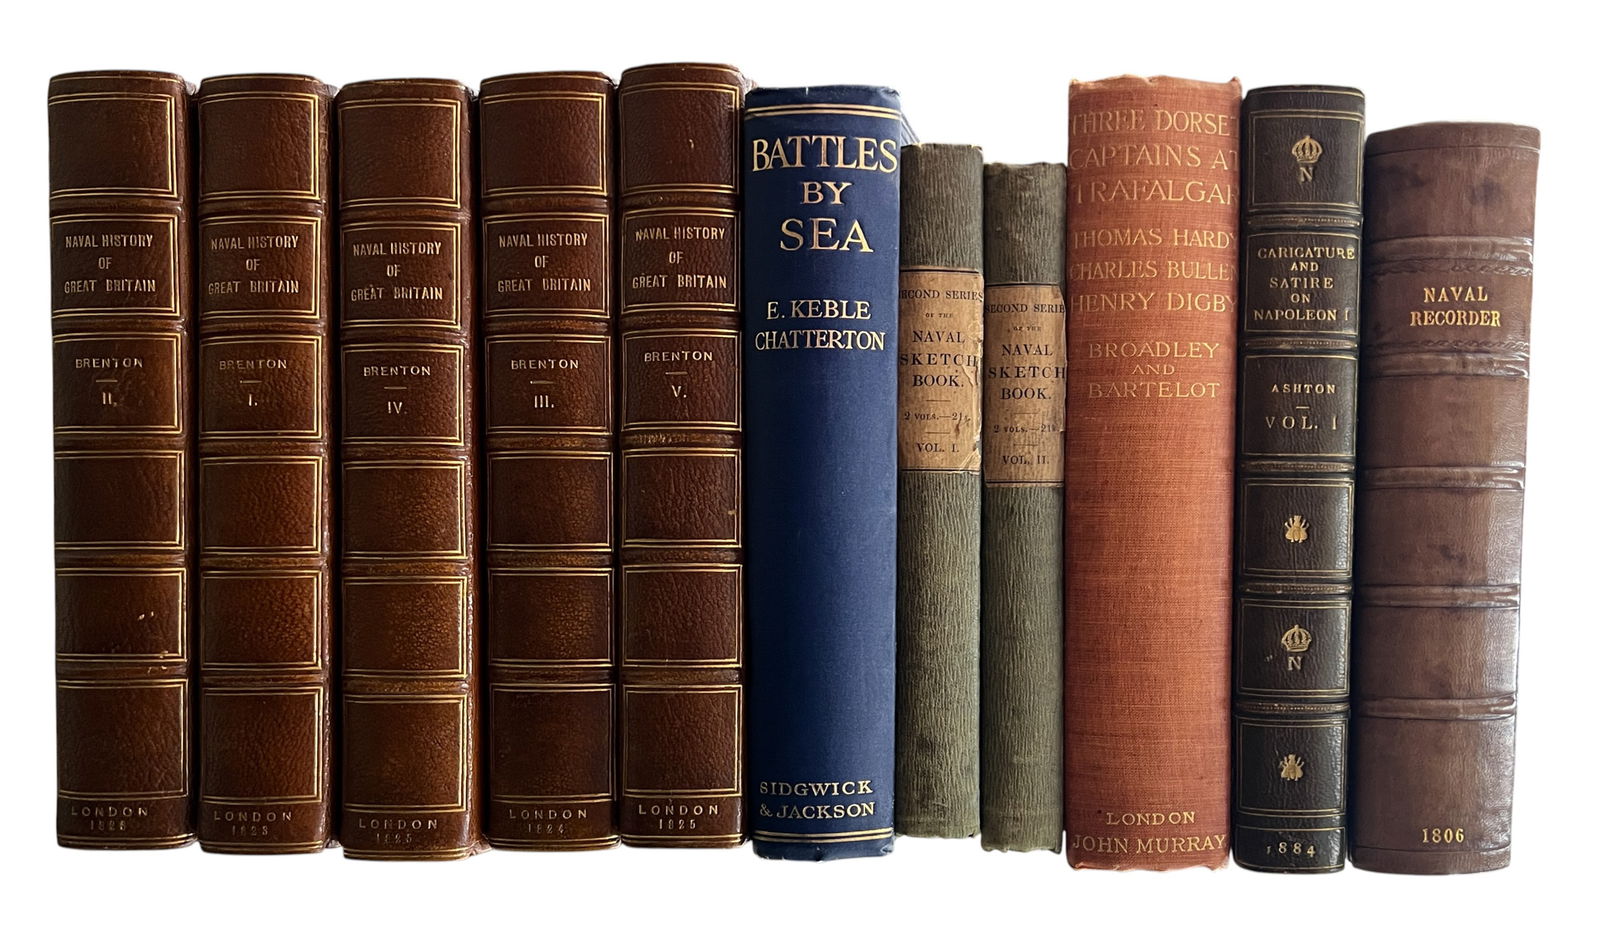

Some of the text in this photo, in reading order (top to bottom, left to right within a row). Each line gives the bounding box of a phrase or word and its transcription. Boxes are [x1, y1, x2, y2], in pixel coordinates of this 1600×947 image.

[1072, 108, 1146, 136] THREE
[752, 135, 898, 173] BATTLES
[1069, 144, 1201, 170] CAPTAINS
[1299, 166, 1314, 183] N
[800, 180, 852, 205] BY
[65, 233, 153, 248] NAVAL HISTORY
[499, 232, 588, 248] NAVAL HISTORY
[635, 226, 725, 242] NAVAL HISTORY
[779, 217, 874, 253] SEA
[1072, 228, 1163, 249] THOMAS
[211, 235, 299, 250] NAVAL HISTORY
[352, 241, 442, 257] NAVAL HISTORY
[668, 251, 684, 264] OF
[1257, 246, 1356, 260] CARICATURE
[98, 257, 112, 270] OF
[245, 258, 261, 271] OF
[534, 255, 549, 269] OF
[1290, 261, 1320, 272] AND
[386, 264, 401, 277] OF
[1069, 260, 1158, 281] CHARLES
[64, 279, 156, 294] GREAT BRITAIN
[208, 280, 299, 295] GREAT BRITAIN
[497, 277, 591, 293] GREAT BRITAIN
[632, 274, 727, 289] GREAT BRITAIN
[1269, 277, 1335, 289] SATIRE
[351, 286, 443, 301] GREAT BRITAIN
[899, 289, 984, 303] ECOND SERIES
[1290, 293, 1311, 304] ON
[1423, 286, 1489, 303] NAVAL
[766, 299, 871, 320] E. KEBLE
[1033, 303, 1066, 314] SERIE
[1070, 292, 1239, 313] HENRY DIGBY
[1253, 309, 1338, 322] NAPOLEON
[1409, 310, 1501, 327] RECORDER
[755, 329, 886, 352] CHATTERTON
[912, 330, 966, 343] NAVAL
[644, 350, 713, 362] BRENTON
[1002, 343, 1053, 357] NAVAL
[1088, 341, 1221, 359] BROADLEY
[75, 357, 143, 369] BRENTON
[219, 359, 287, 371] BRENTON
[511, 359, 579, 370] BRENTON
[900, 353, 978, 367] SKETCH
[363, 365, 431, 377] BRENTON
[988, 366, 1066, 379] SKETCH
[1131, 364, 1175, 376] AND
[912, 374, 965, 387] BOOK.
[671, 385, 687, 398] V.
[1000, 387, 1052, 401] BOOK.
[1088, 382, 1221, 399] BARTELOT
[1271, 383, 1337, 394] ASHTON
[904, 411, 911, 421] 2
[993, 424, 1000, 433] 2
[1265, 416, 1319, 431] VOL.
[916, 442, 960, 453] VOL. I.
[1287, 656, 1303, 671] N
[759, 780, 874, 797] SIDGWICK
[71, 806, 148, 817] LONDON
[213, 810, 292, 822] LONDON
[509, 808, 587, 820] LONDON
[638, 804, 718, 816] LONDON
[759, 801, 876, 819] & JACKSON
[359, 818, 437, 830] LONDON
[1106, 811, 1196, 826] LONDON
[1422, 827, 1465, 844] 1806
[1072, 834, 1227, 854] JOHN MURRAY
[1266, 841, 1316, 858] 1884
